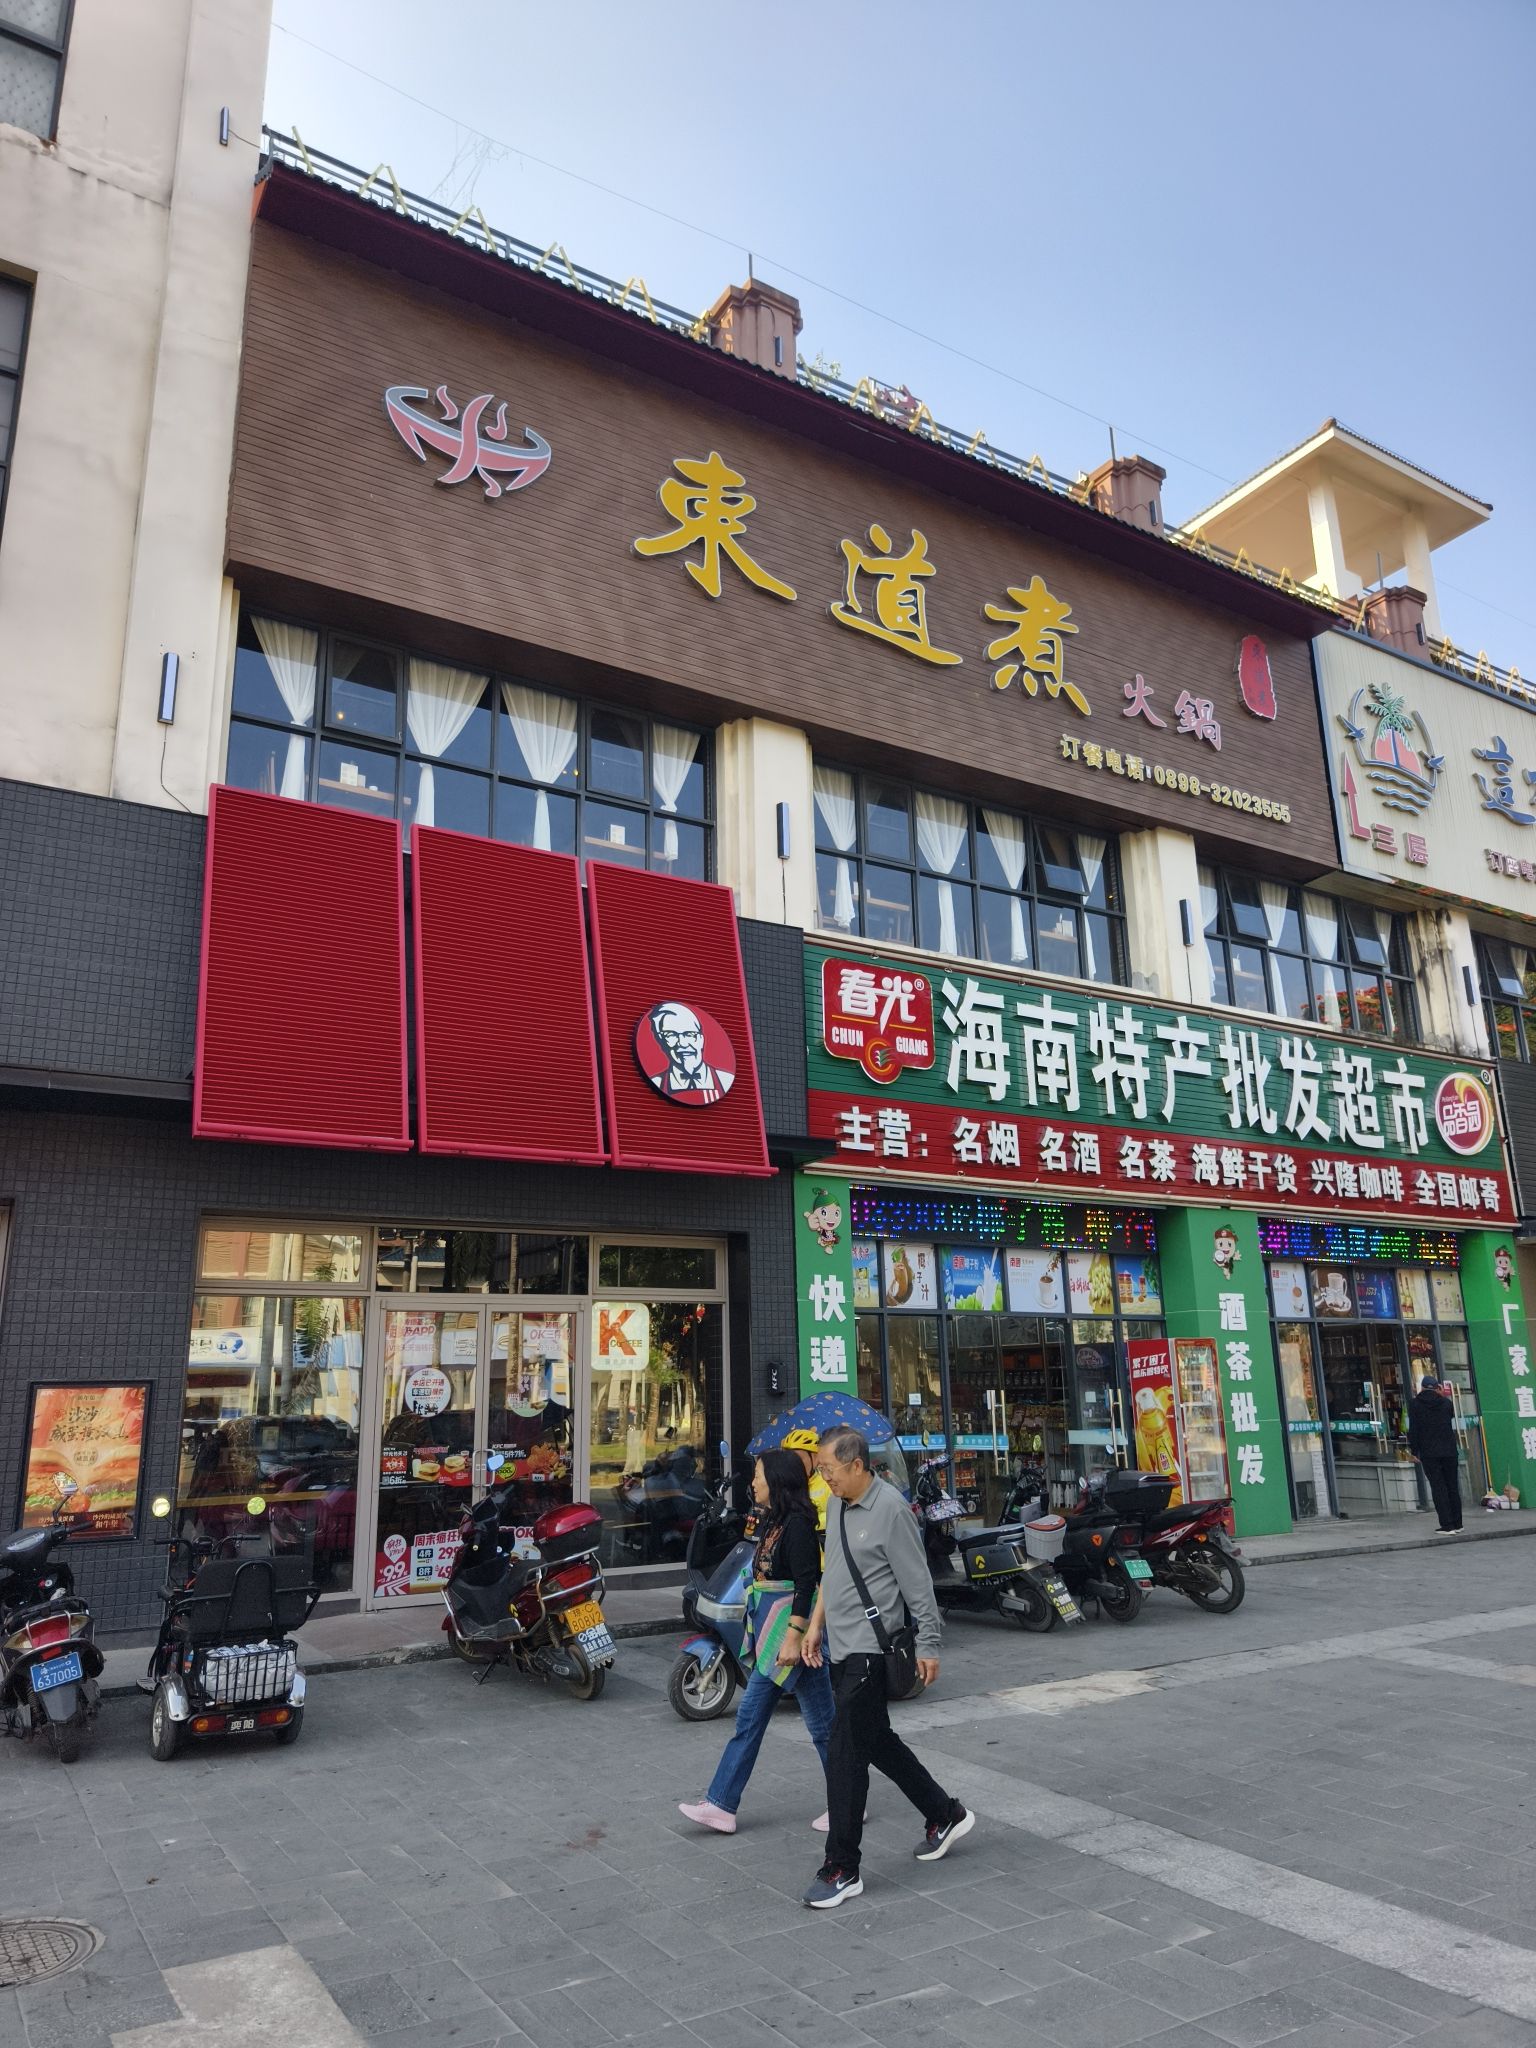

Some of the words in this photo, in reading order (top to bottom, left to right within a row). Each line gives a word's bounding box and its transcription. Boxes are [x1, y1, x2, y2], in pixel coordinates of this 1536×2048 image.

[1122, 674, 1222, 750] 火鍋
[838, 968, 917, 1035] 春光
[832, 1026, 864, 1047] CHUN
[896, 1036, 928, 1056] GUANG
[941, 977, 1428, 1155] 海南特产批发超市
[953, 1116, 1020, 1167] 名烟
[1040, 1126, 1101, 1175] 名酒
[1119, 1135, 1176, 1183] 名茶
[1191, 1143, 1298, 1194] 海鲜干货
[1311, 1158, 1403, 1202] 兴隆咖啡
[1415, 1169, 1500, 1213] 全国邮寄
[808, 1274, 848, 1383] 快递
[1218, 1292, 1265, 1485] 酒茶批发
[415, 1530, 460, 1547] 周末疯狂
[37, 1665, 78, 1688] 637005
